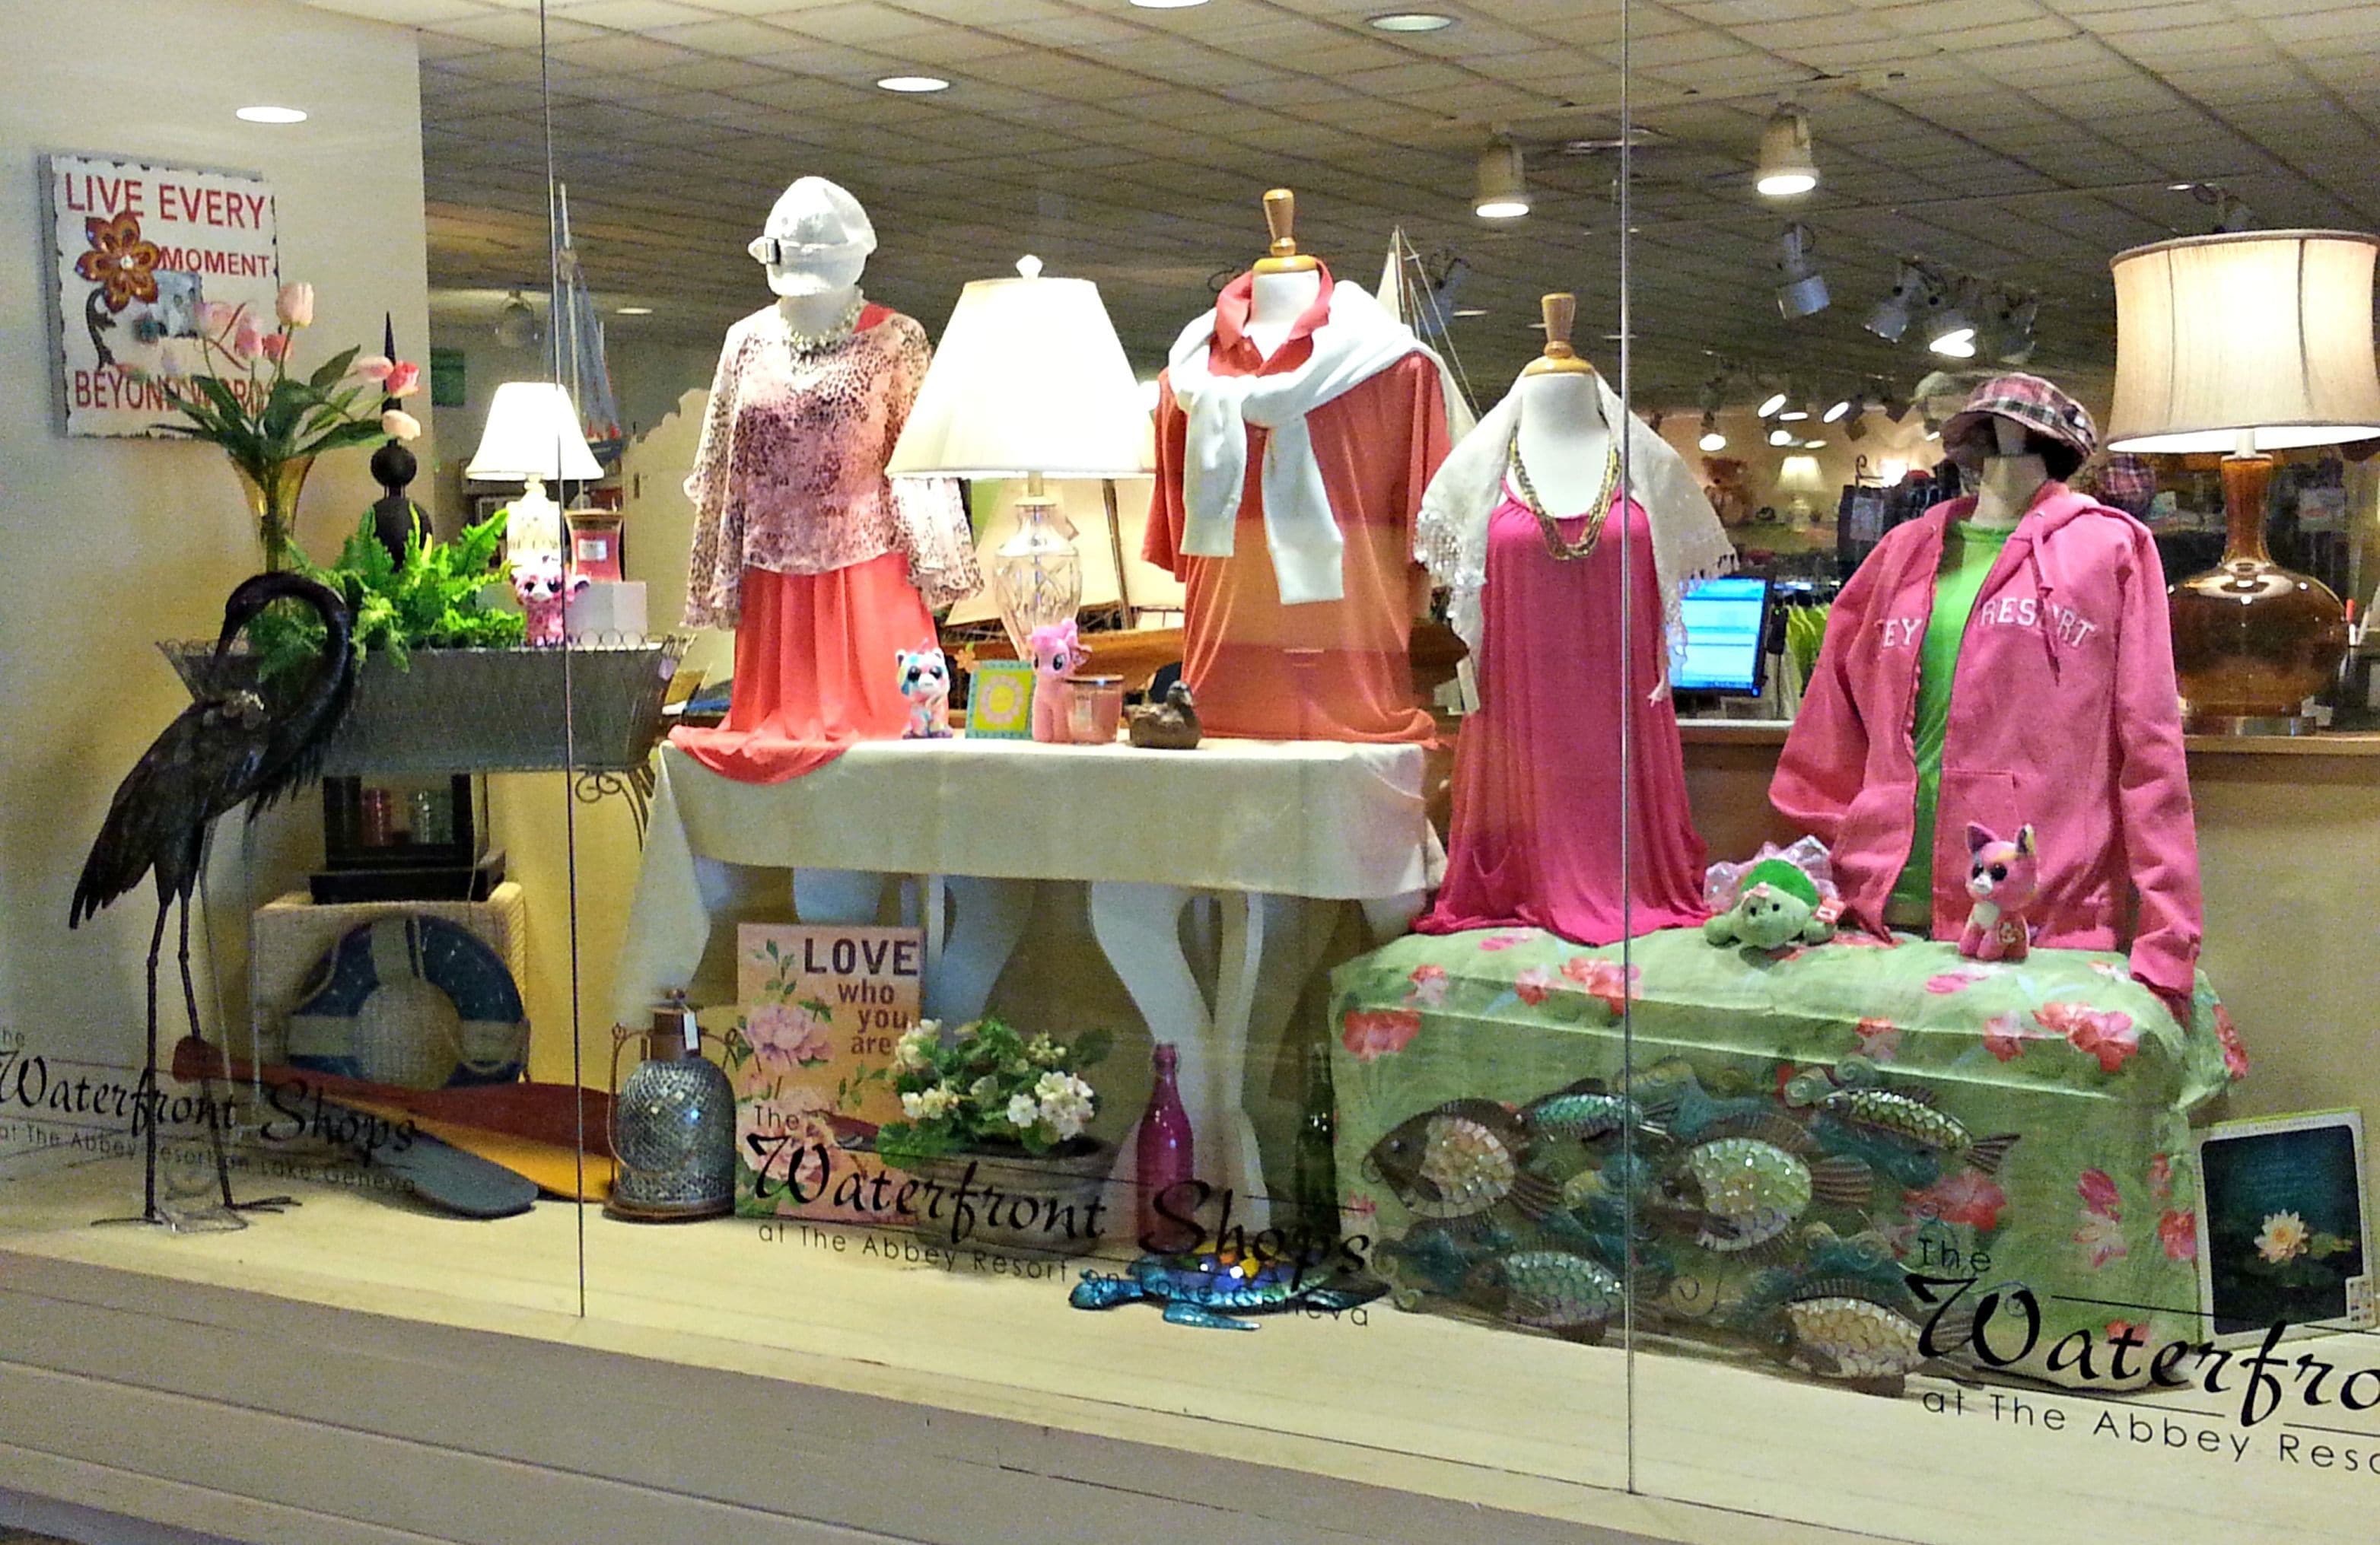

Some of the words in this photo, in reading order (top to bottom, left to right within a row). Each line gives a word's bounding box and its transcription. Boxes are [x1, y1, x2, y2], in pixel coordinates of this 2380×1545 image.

[65, 173, 144, 218] LIVE
[159, 183, 265, 229] EVERY
[158, 246, 269, 278] MOMENT
[1875, 618, 1922, 647] EY
[1980, 597, 2098, 647] RESRT
[804, 938, 918, 975] LOVE
[838, 979, 895, 1004] who
[0, 1029, 25, 1047] he
[858, 1009, 908, 1033] you
[851, 1036, 891, 1055] are
[260, 1079, 417, 1168] Shops
[753, 1105, 800, 1130] The
[27, 1124, 60, 1145] The
[70, 1131, 137, 1160] Abbey
[149, 1141, 216, 1166] esort
[261, 1159, 313, 1181] Lake
[324, 1170, 416, 1194] Geneva
[746, 1133, 1108, 1244] Waterfront
[1141, 1179, 1370, 1293] Shops
[759, 1222, 784, 1244] at
[801, 1225, 846, 1252] The
[862, 1232, 956, 1273] Abbey
[972, 1252, 1067, 1283] Resort
[1084, 1268, 1121, 1289] on
[1918, 1238, 1991, 1273] The
[1904, 1273, 2380, 1427] Waterfro
[1922, 1387, 1965, 1416] at
[1990, 1392, 2066, 1431] The
[2092, 1410, 2251, 1463] Abbey
